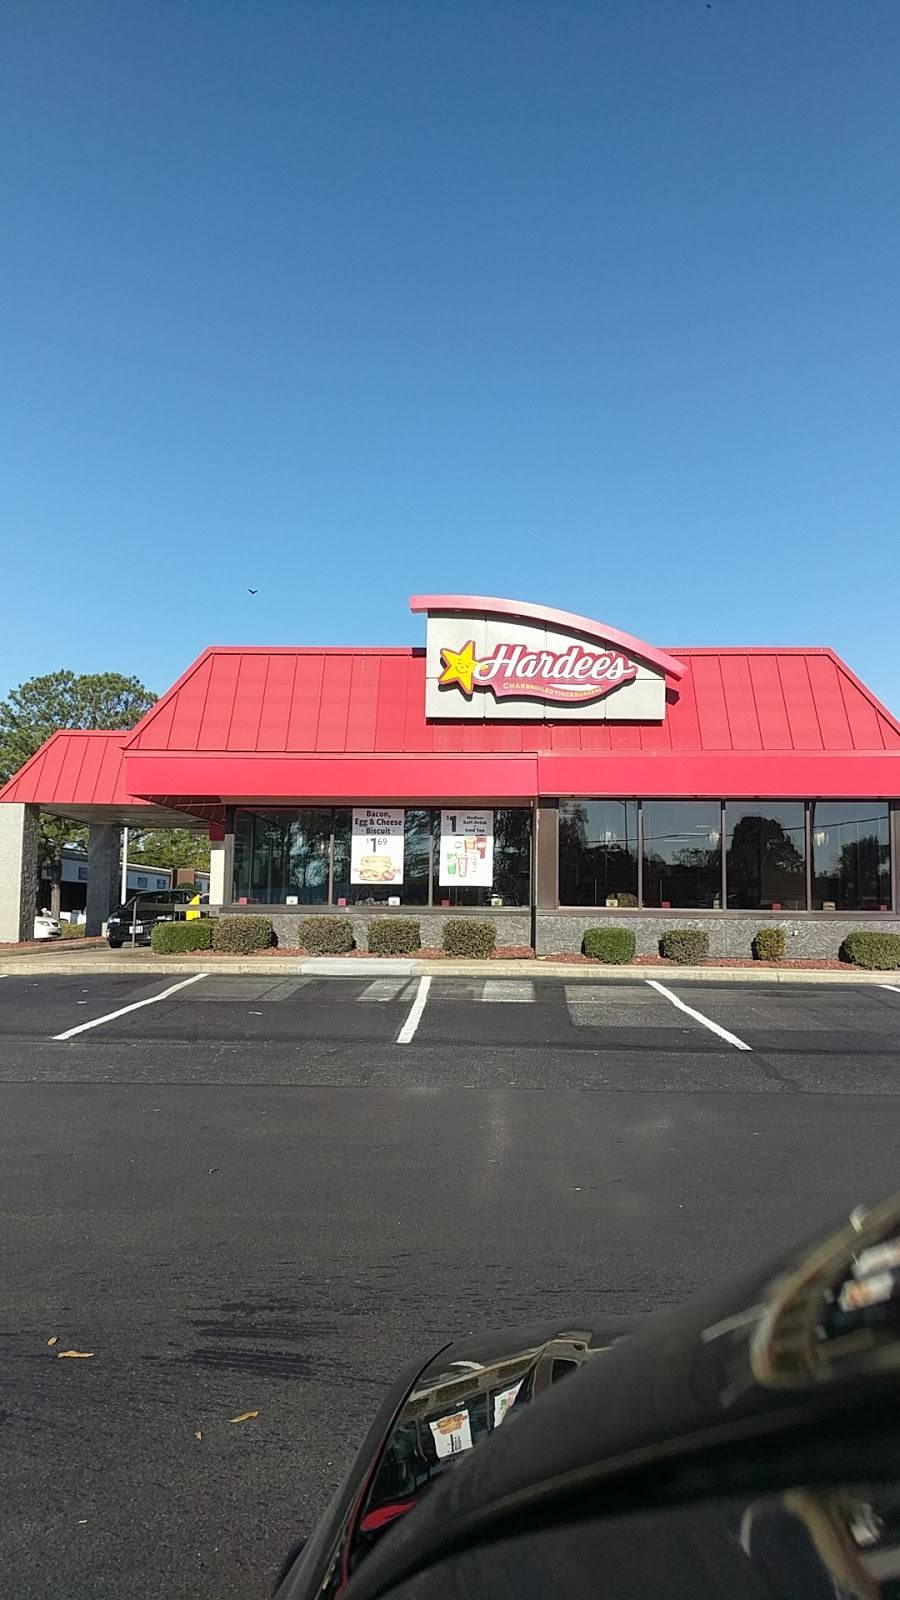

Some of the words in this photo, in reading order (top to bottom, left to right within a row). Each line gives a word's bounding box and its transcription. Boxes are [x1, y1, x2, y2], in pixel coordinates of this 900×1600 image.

[473, 645, 635, 680] Hardee's
[366, 810, 391, 818] Bacon,
[355, 817, 368, 827] Egg
[369, 818, 375, 826] &
[376, 818, 402, 826] Cheese
[445, 815, 457, 833] $1
[366, 827, 391, 835] Biscuit
